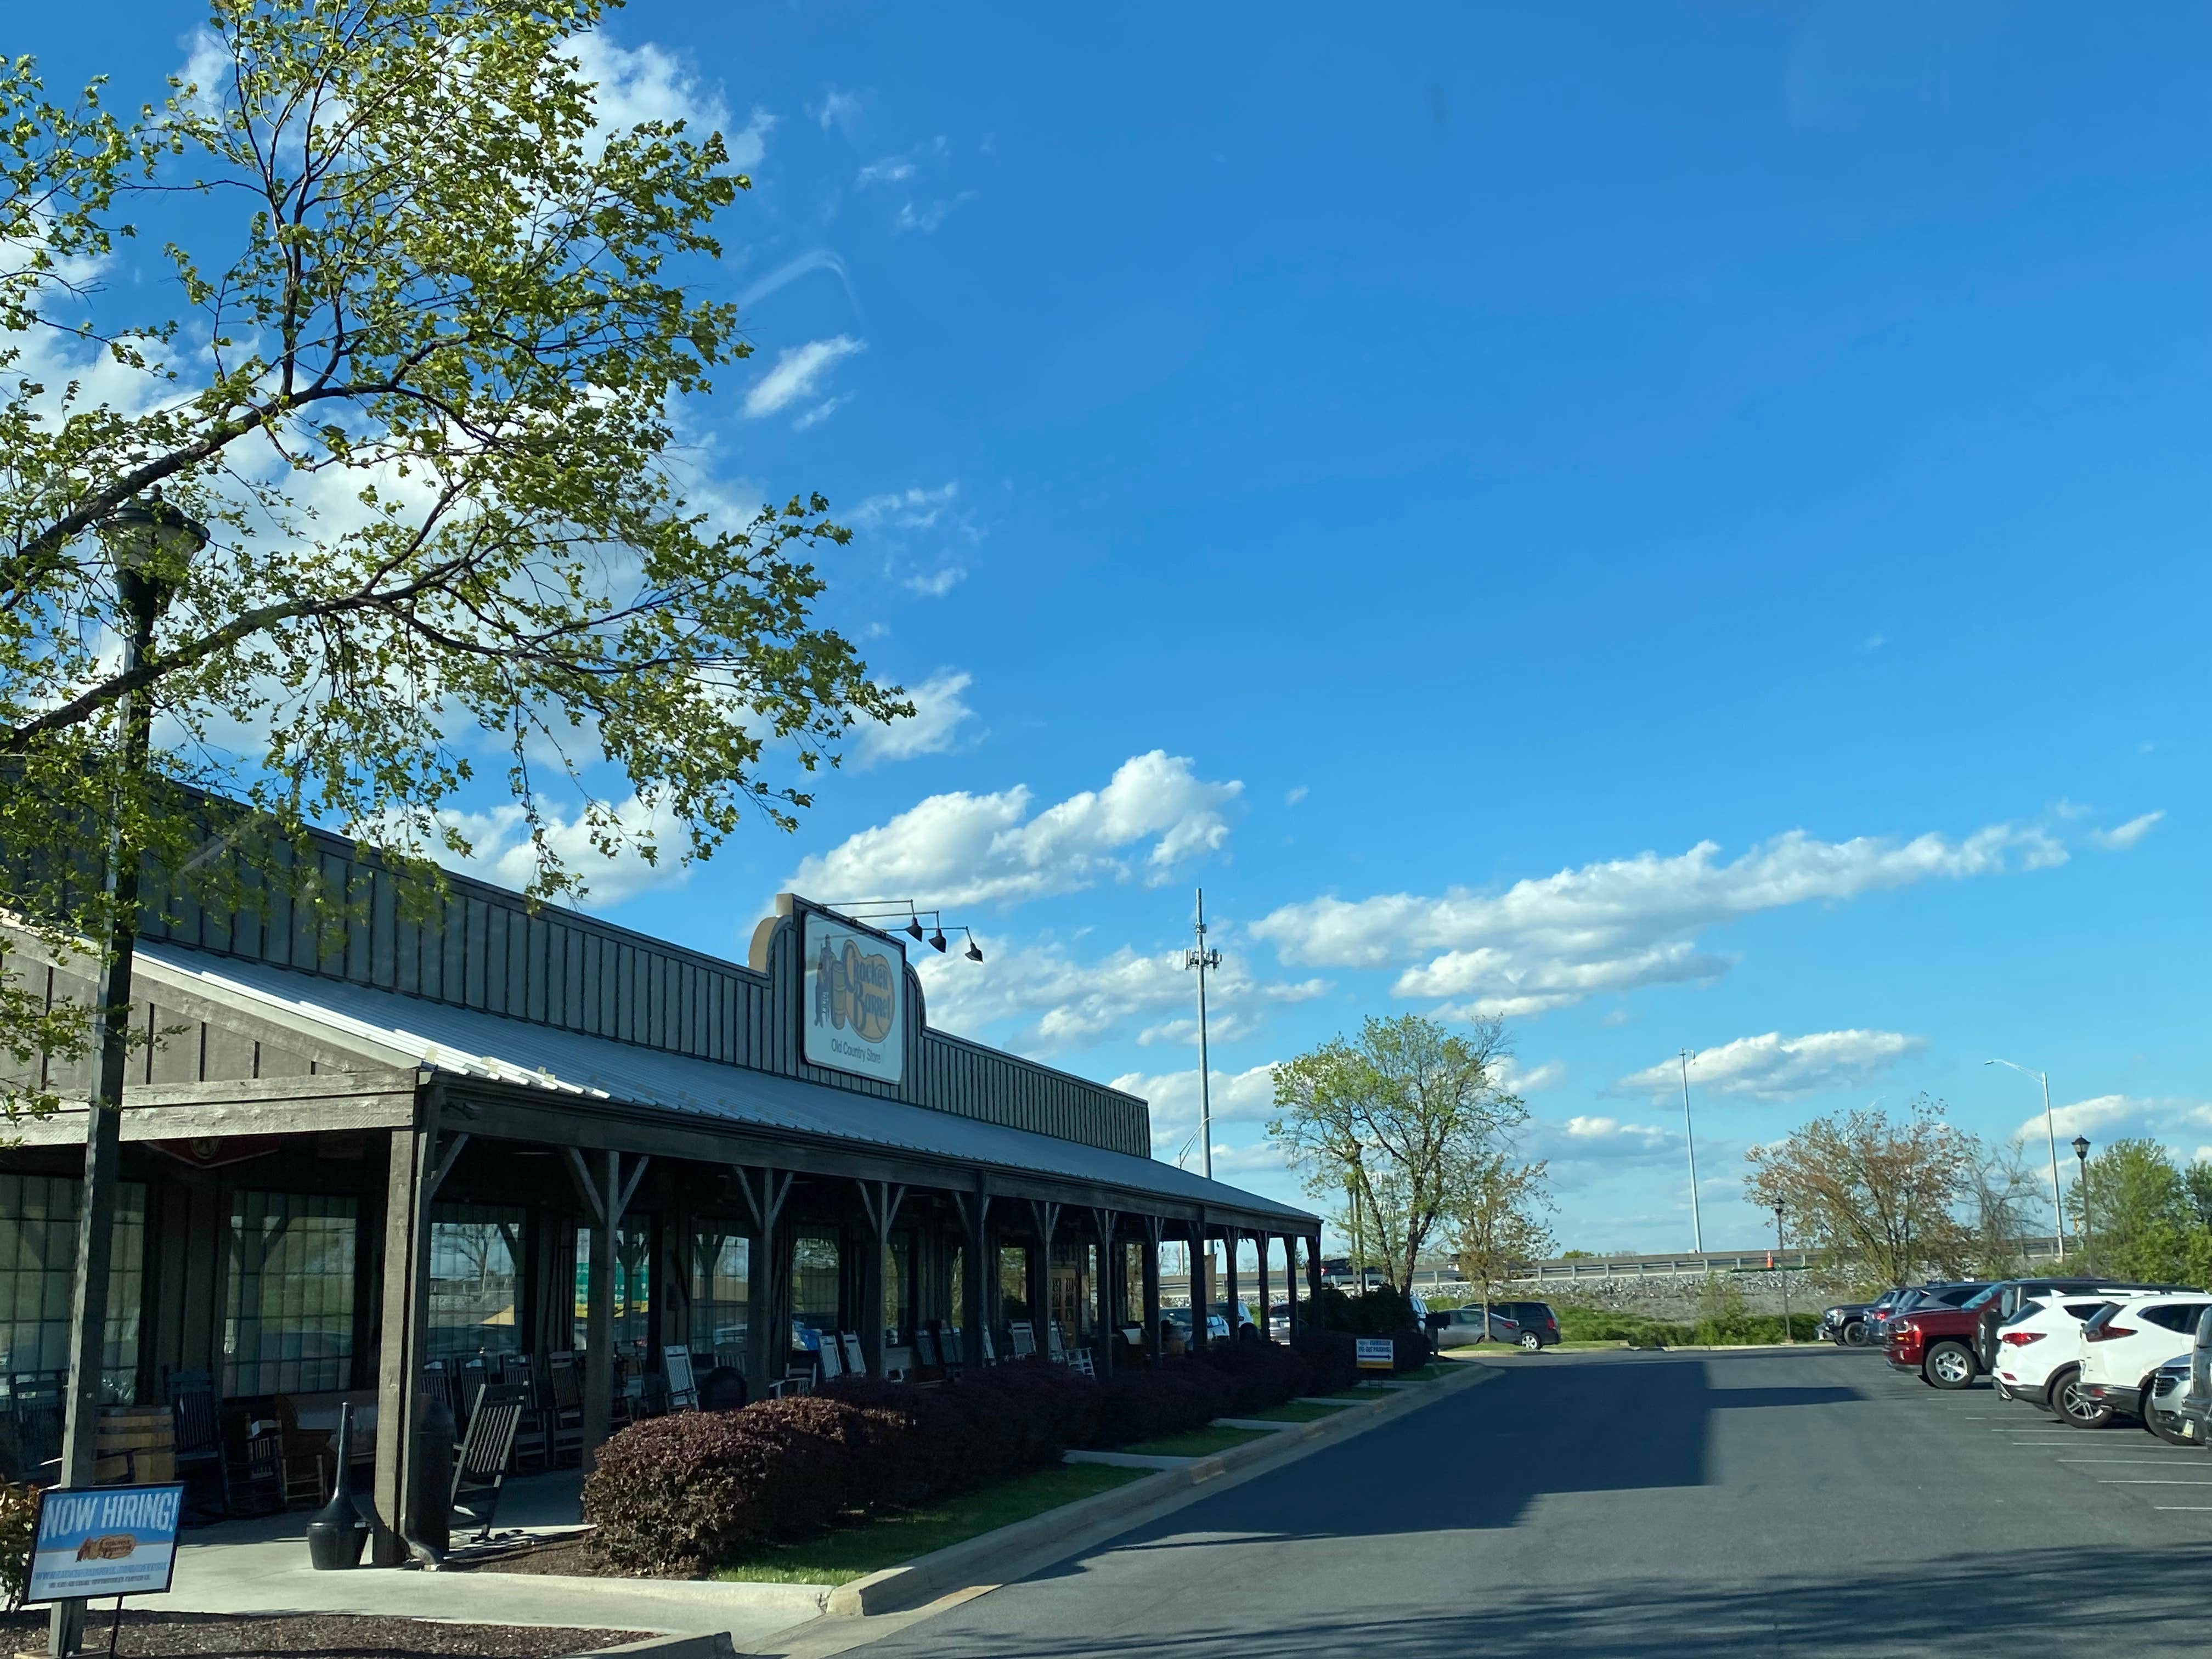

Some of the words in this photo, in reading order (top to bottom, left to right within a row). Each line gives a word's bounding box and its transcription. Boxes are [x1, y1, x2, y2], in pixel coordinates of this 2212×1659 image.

[831, 1038, 843, 1054] Old
[843, 1041, 866, 1063] Country
[866, 1047, 881, 1064] Store
[41, 1497, 98, 1541] NOW
[100, 1492, 180, 1532] HIRING!
